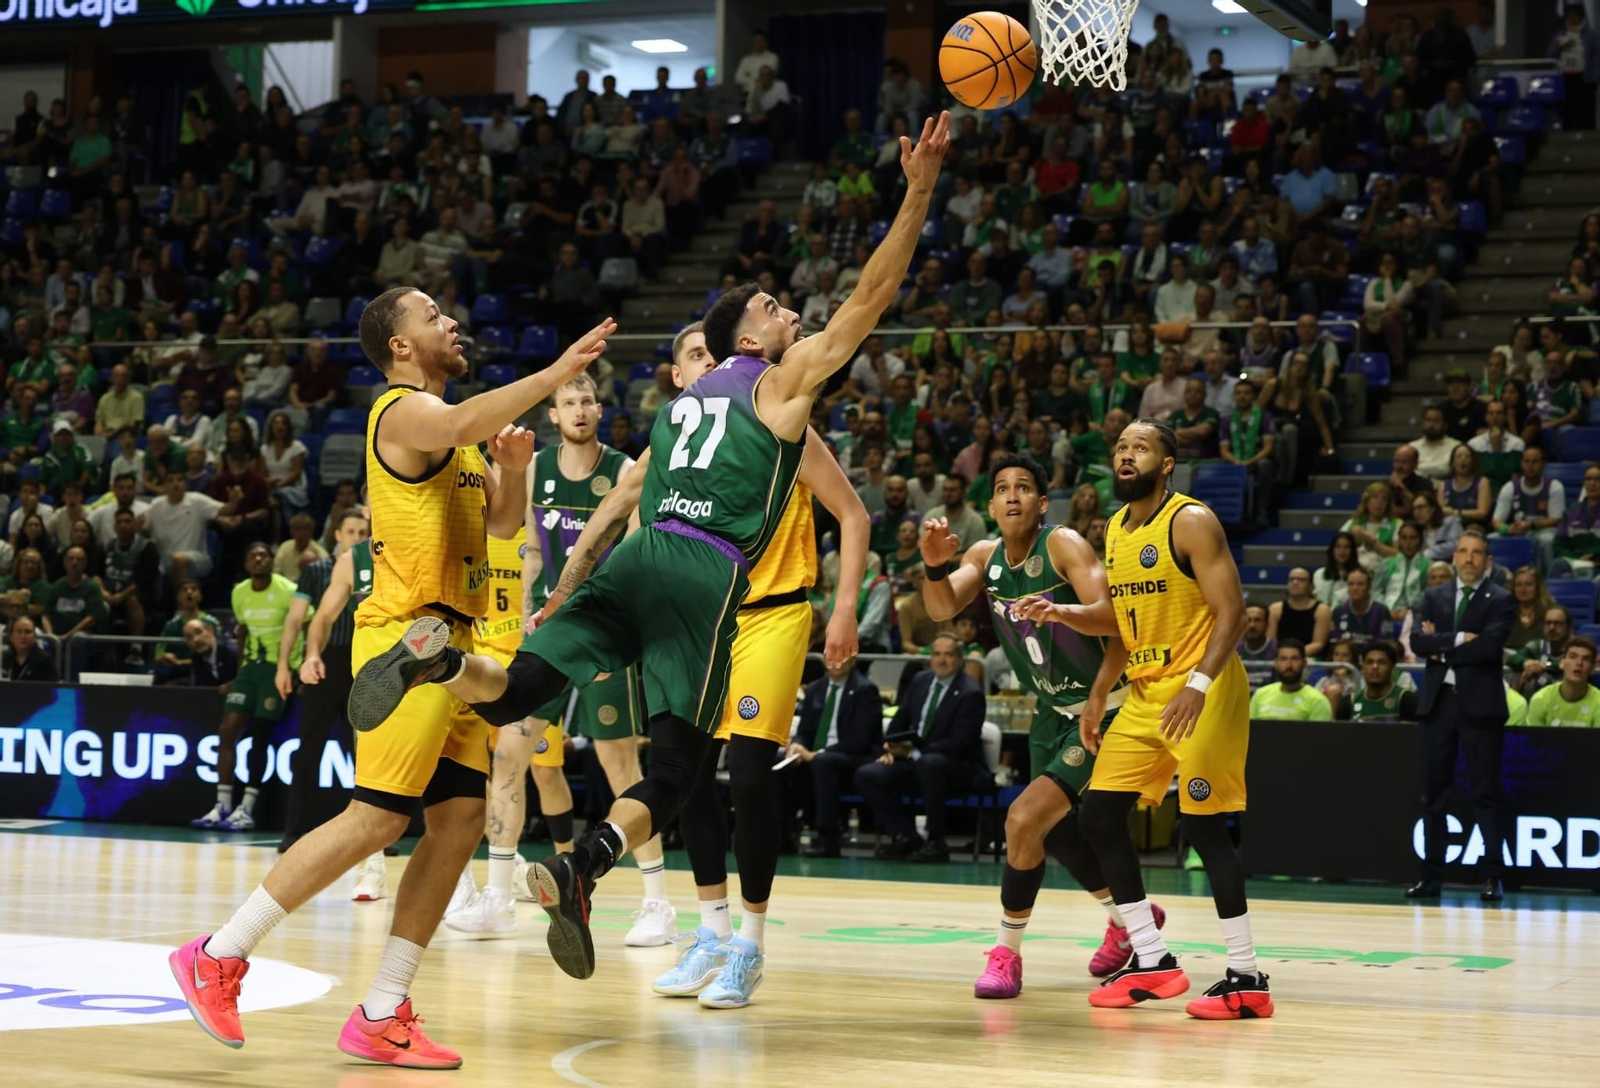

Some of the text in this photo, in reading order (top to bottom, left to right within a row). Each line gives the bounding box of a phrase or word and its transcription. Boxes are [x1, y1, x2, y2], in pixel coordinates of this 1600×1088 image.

[668, 396, 731, 471] 27
[495, 587, 509, 612] 5
[1024, 635, 1044, 665] 0
[112, 731, 188, 780] UP
